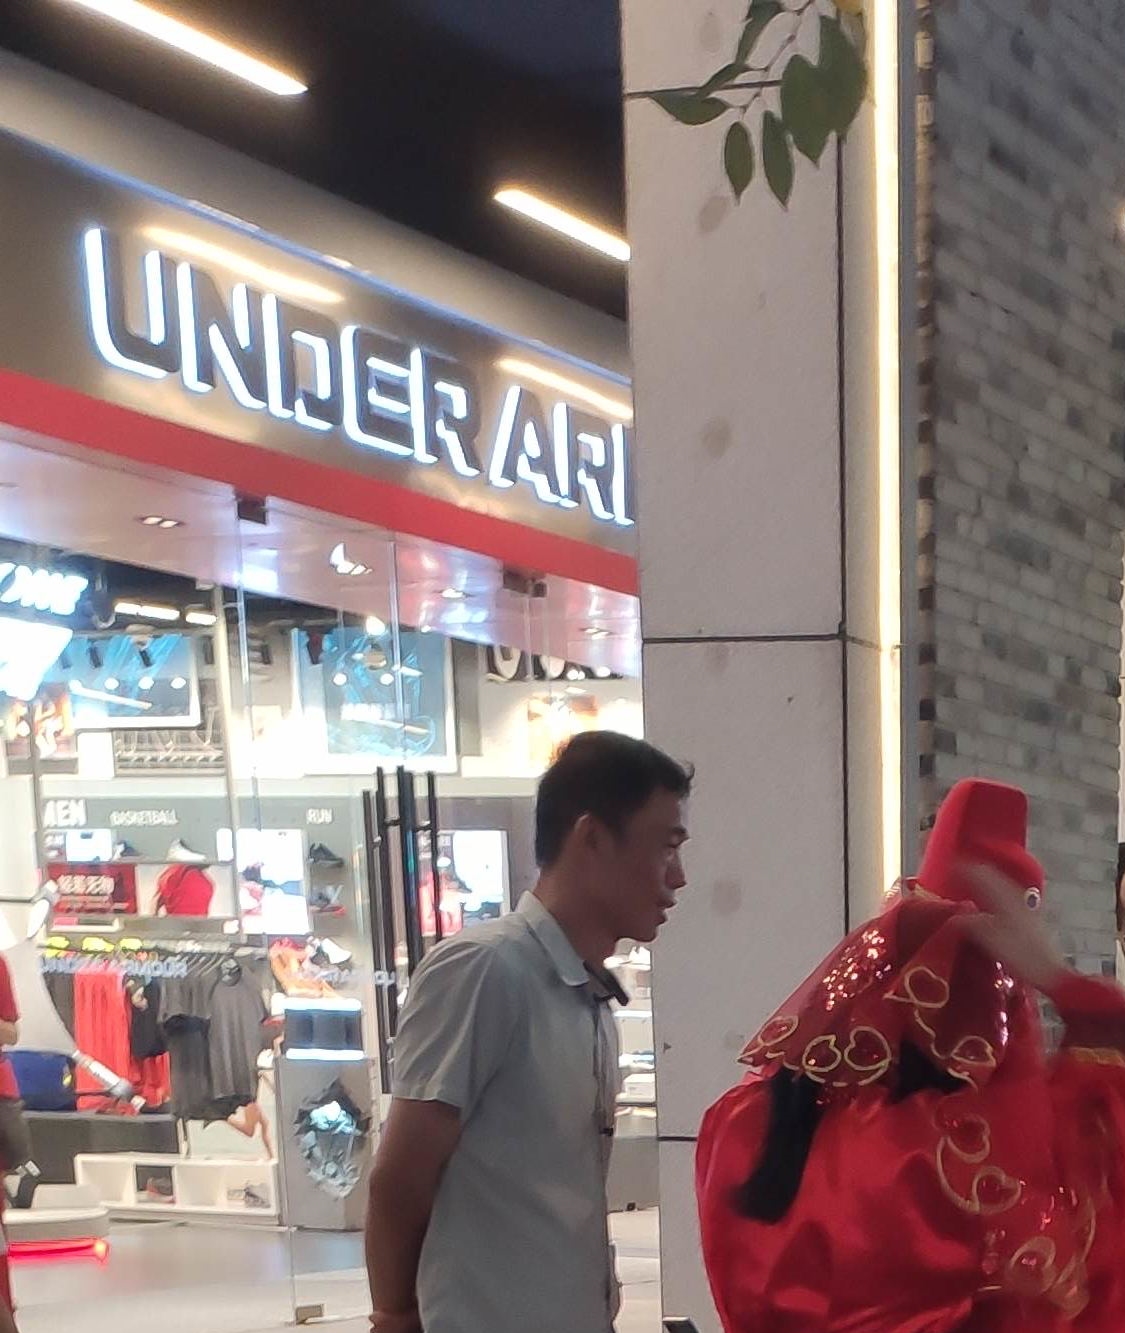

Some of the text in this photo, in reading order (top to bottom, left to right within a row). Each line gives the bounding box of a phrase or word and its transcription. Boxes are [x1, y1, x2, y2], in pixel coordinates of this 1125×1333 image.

[83, 227, 634, 527] UNDER AR
[109, 808, 178, 827] BASKETBALL
[306, 808, 333, 825] RUN
